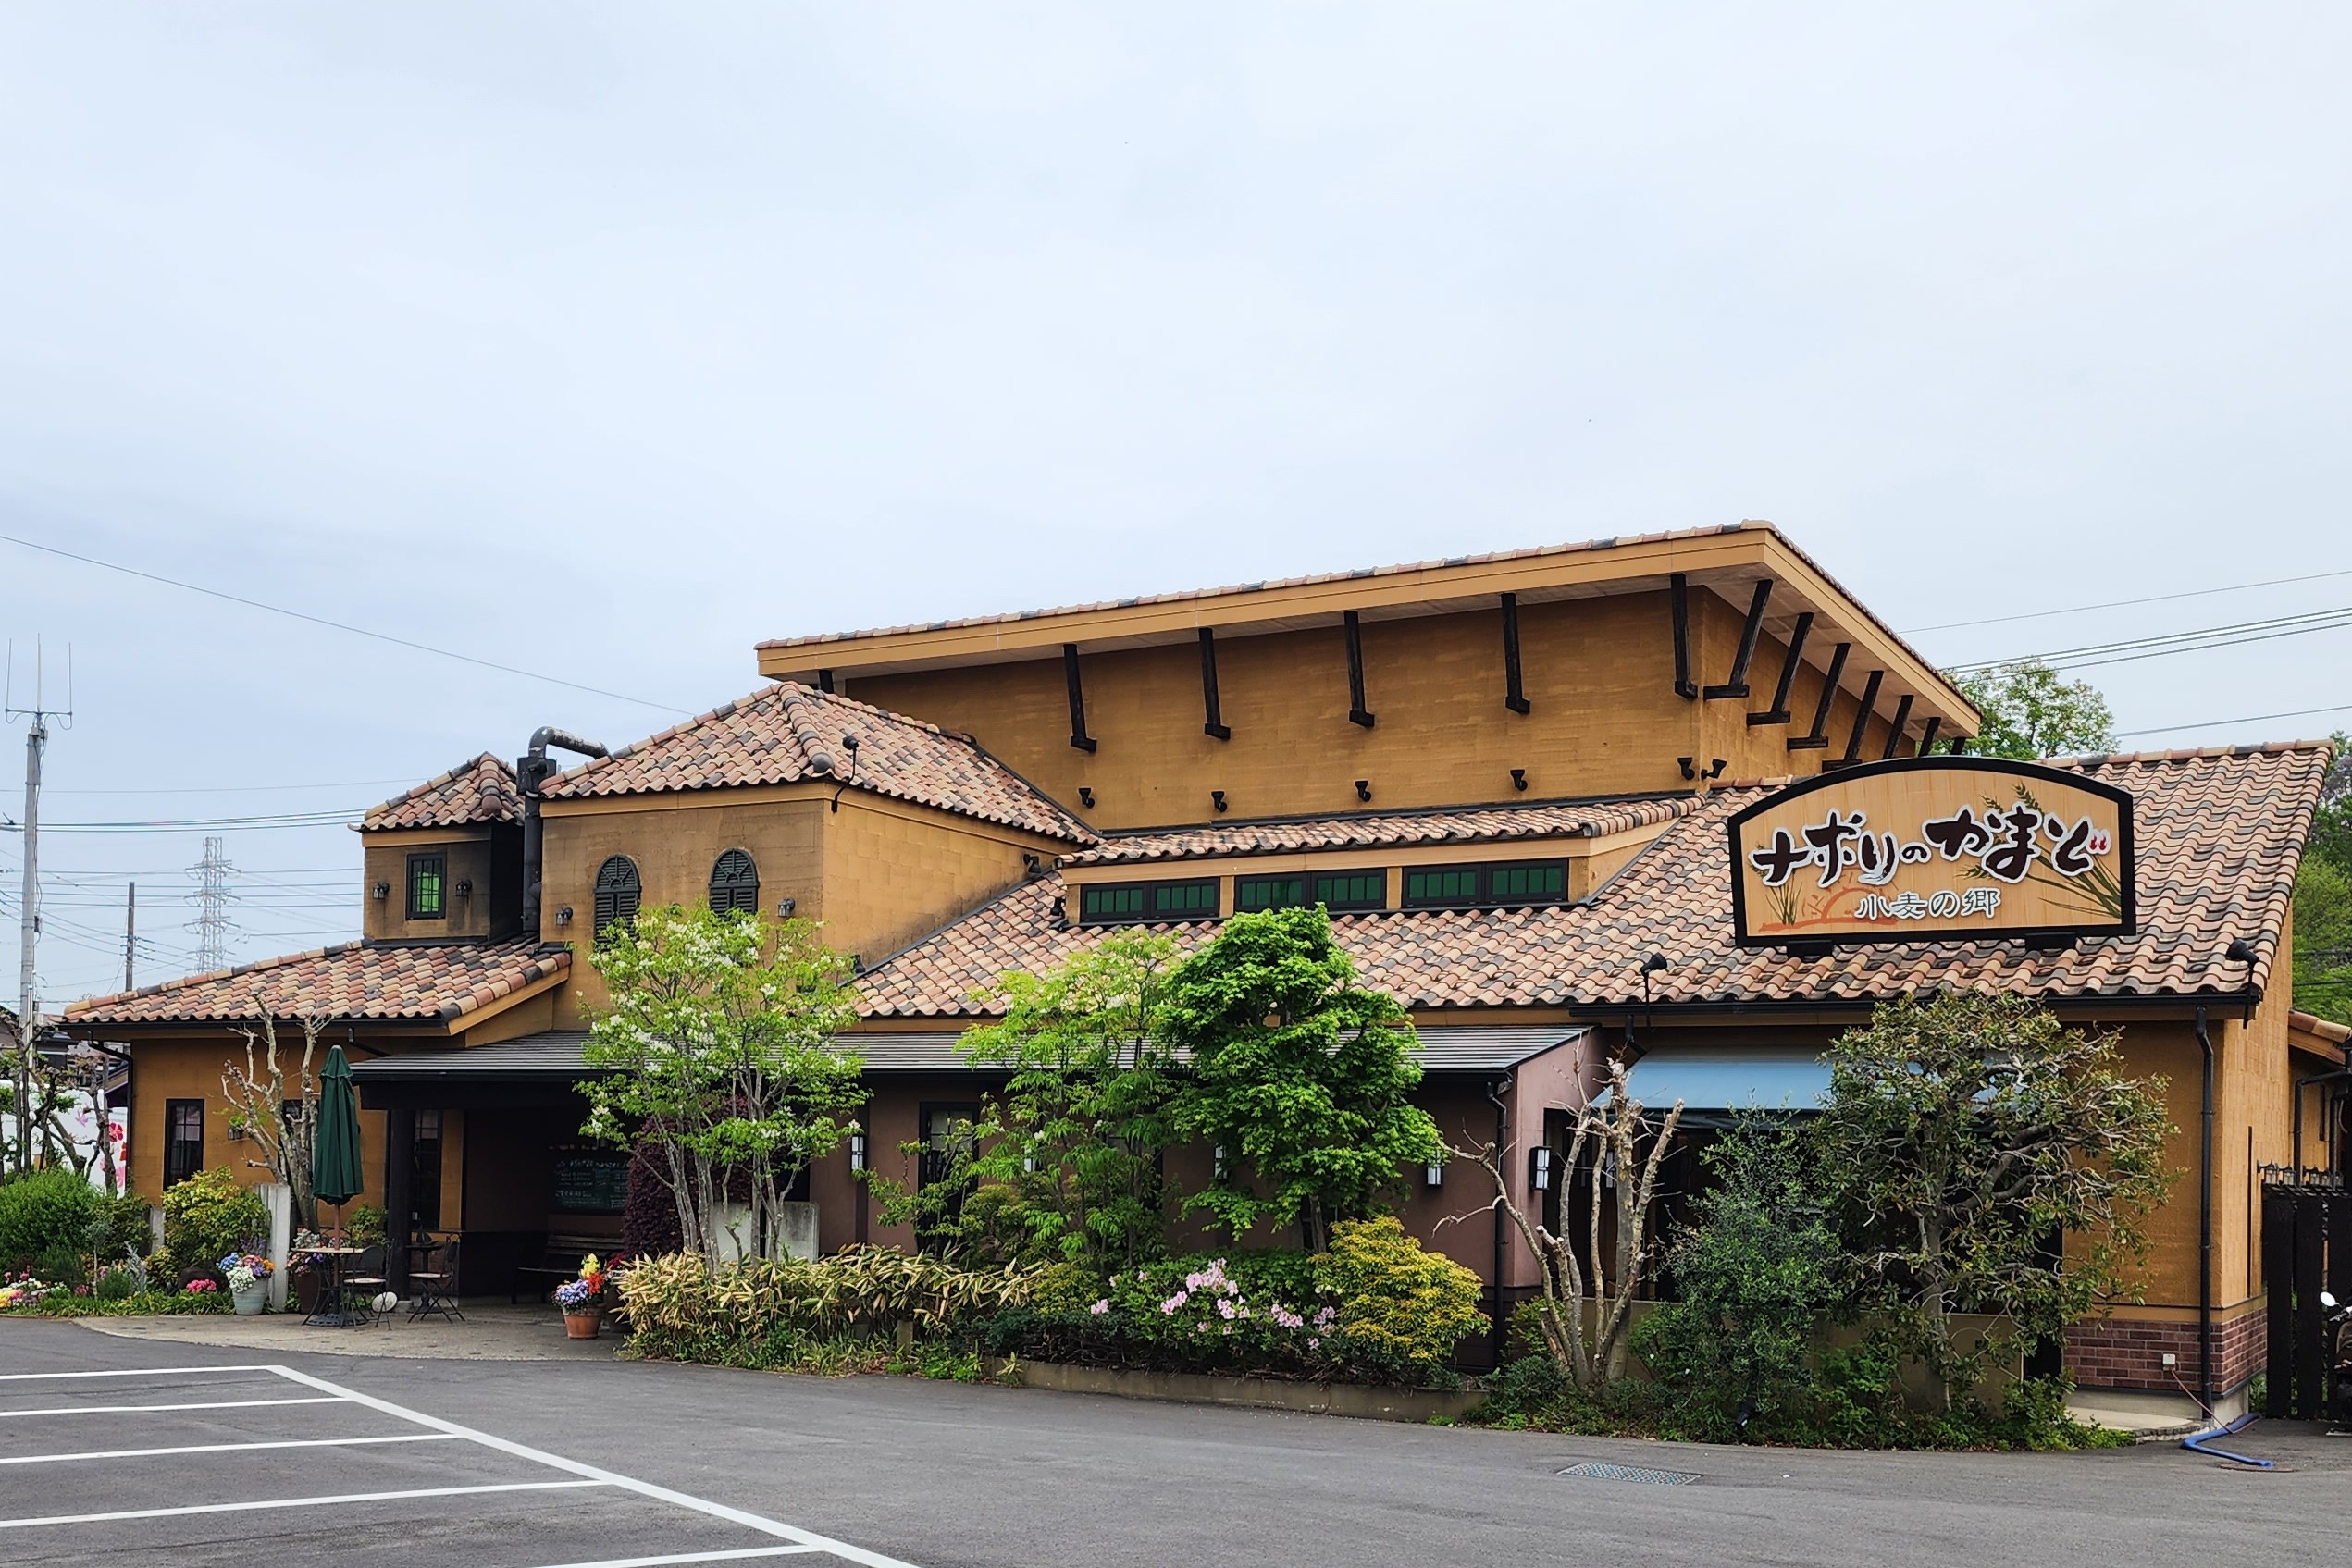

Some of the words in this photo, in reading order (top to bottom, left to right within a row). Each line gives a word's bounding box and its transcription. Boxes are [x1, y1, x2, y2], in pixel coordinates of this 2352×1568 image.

[1751, 804, 2109, 884] ナポリのかまど
[1856, 888, 2000, 918] 小麦の郷
